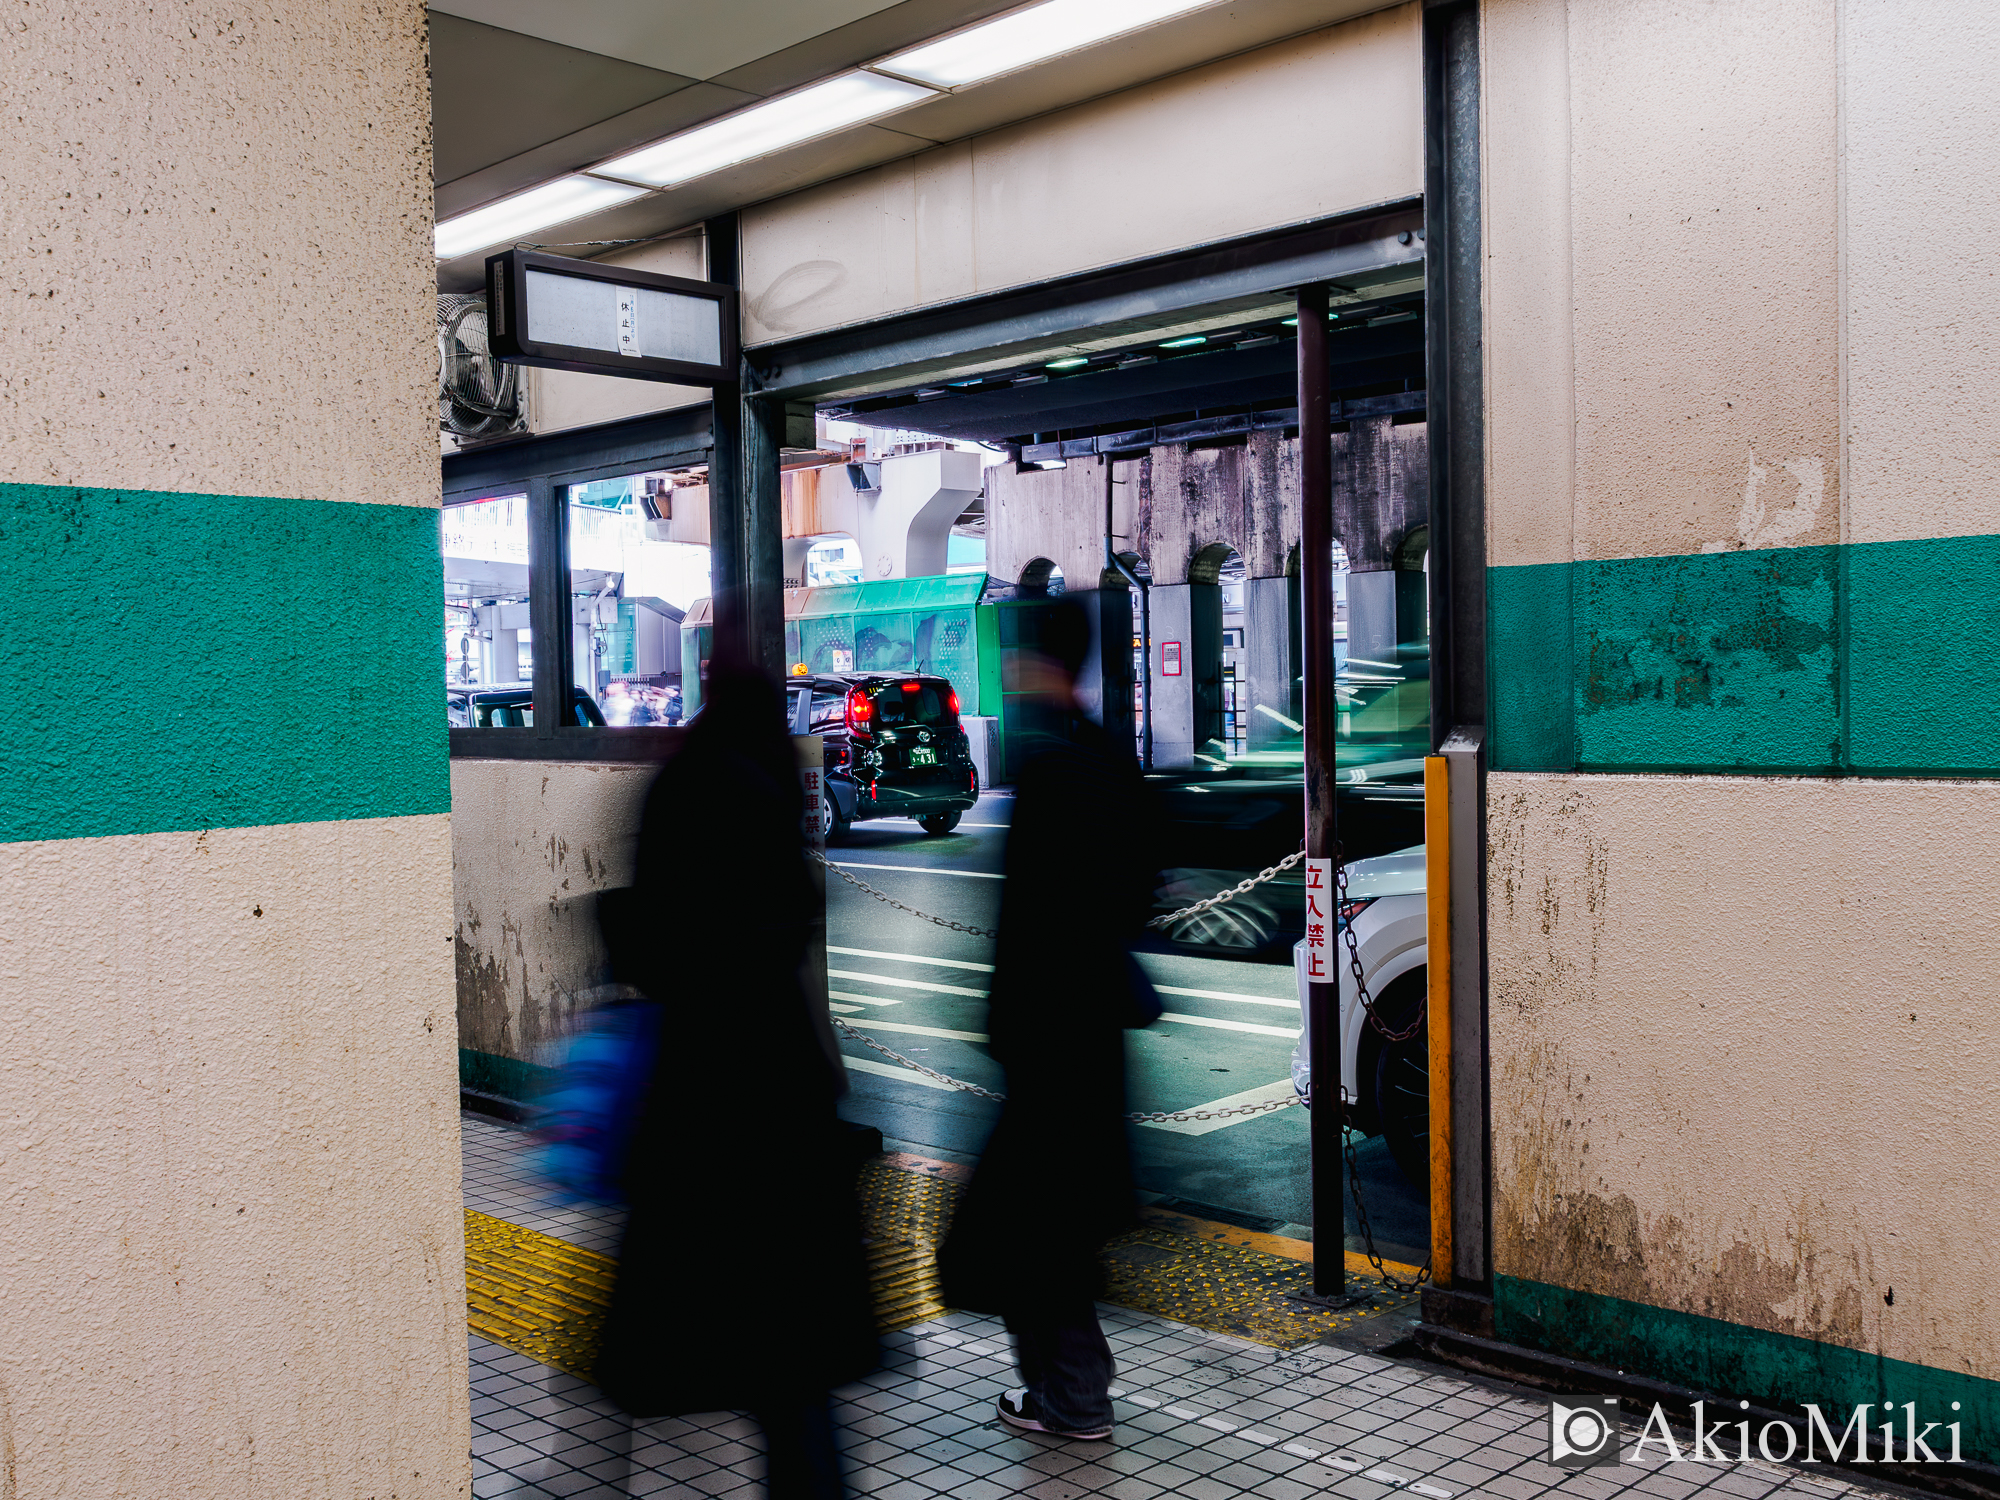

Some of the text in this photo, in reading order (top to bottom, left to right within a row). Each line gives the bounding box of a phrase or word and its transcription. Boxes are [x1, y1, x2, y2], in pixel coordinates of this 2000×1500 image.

[621, 302, 630, 344] 休止中
[1165, 625, 1175, 640] 3
[1306, 865, 1325, 977] 立入禁止
